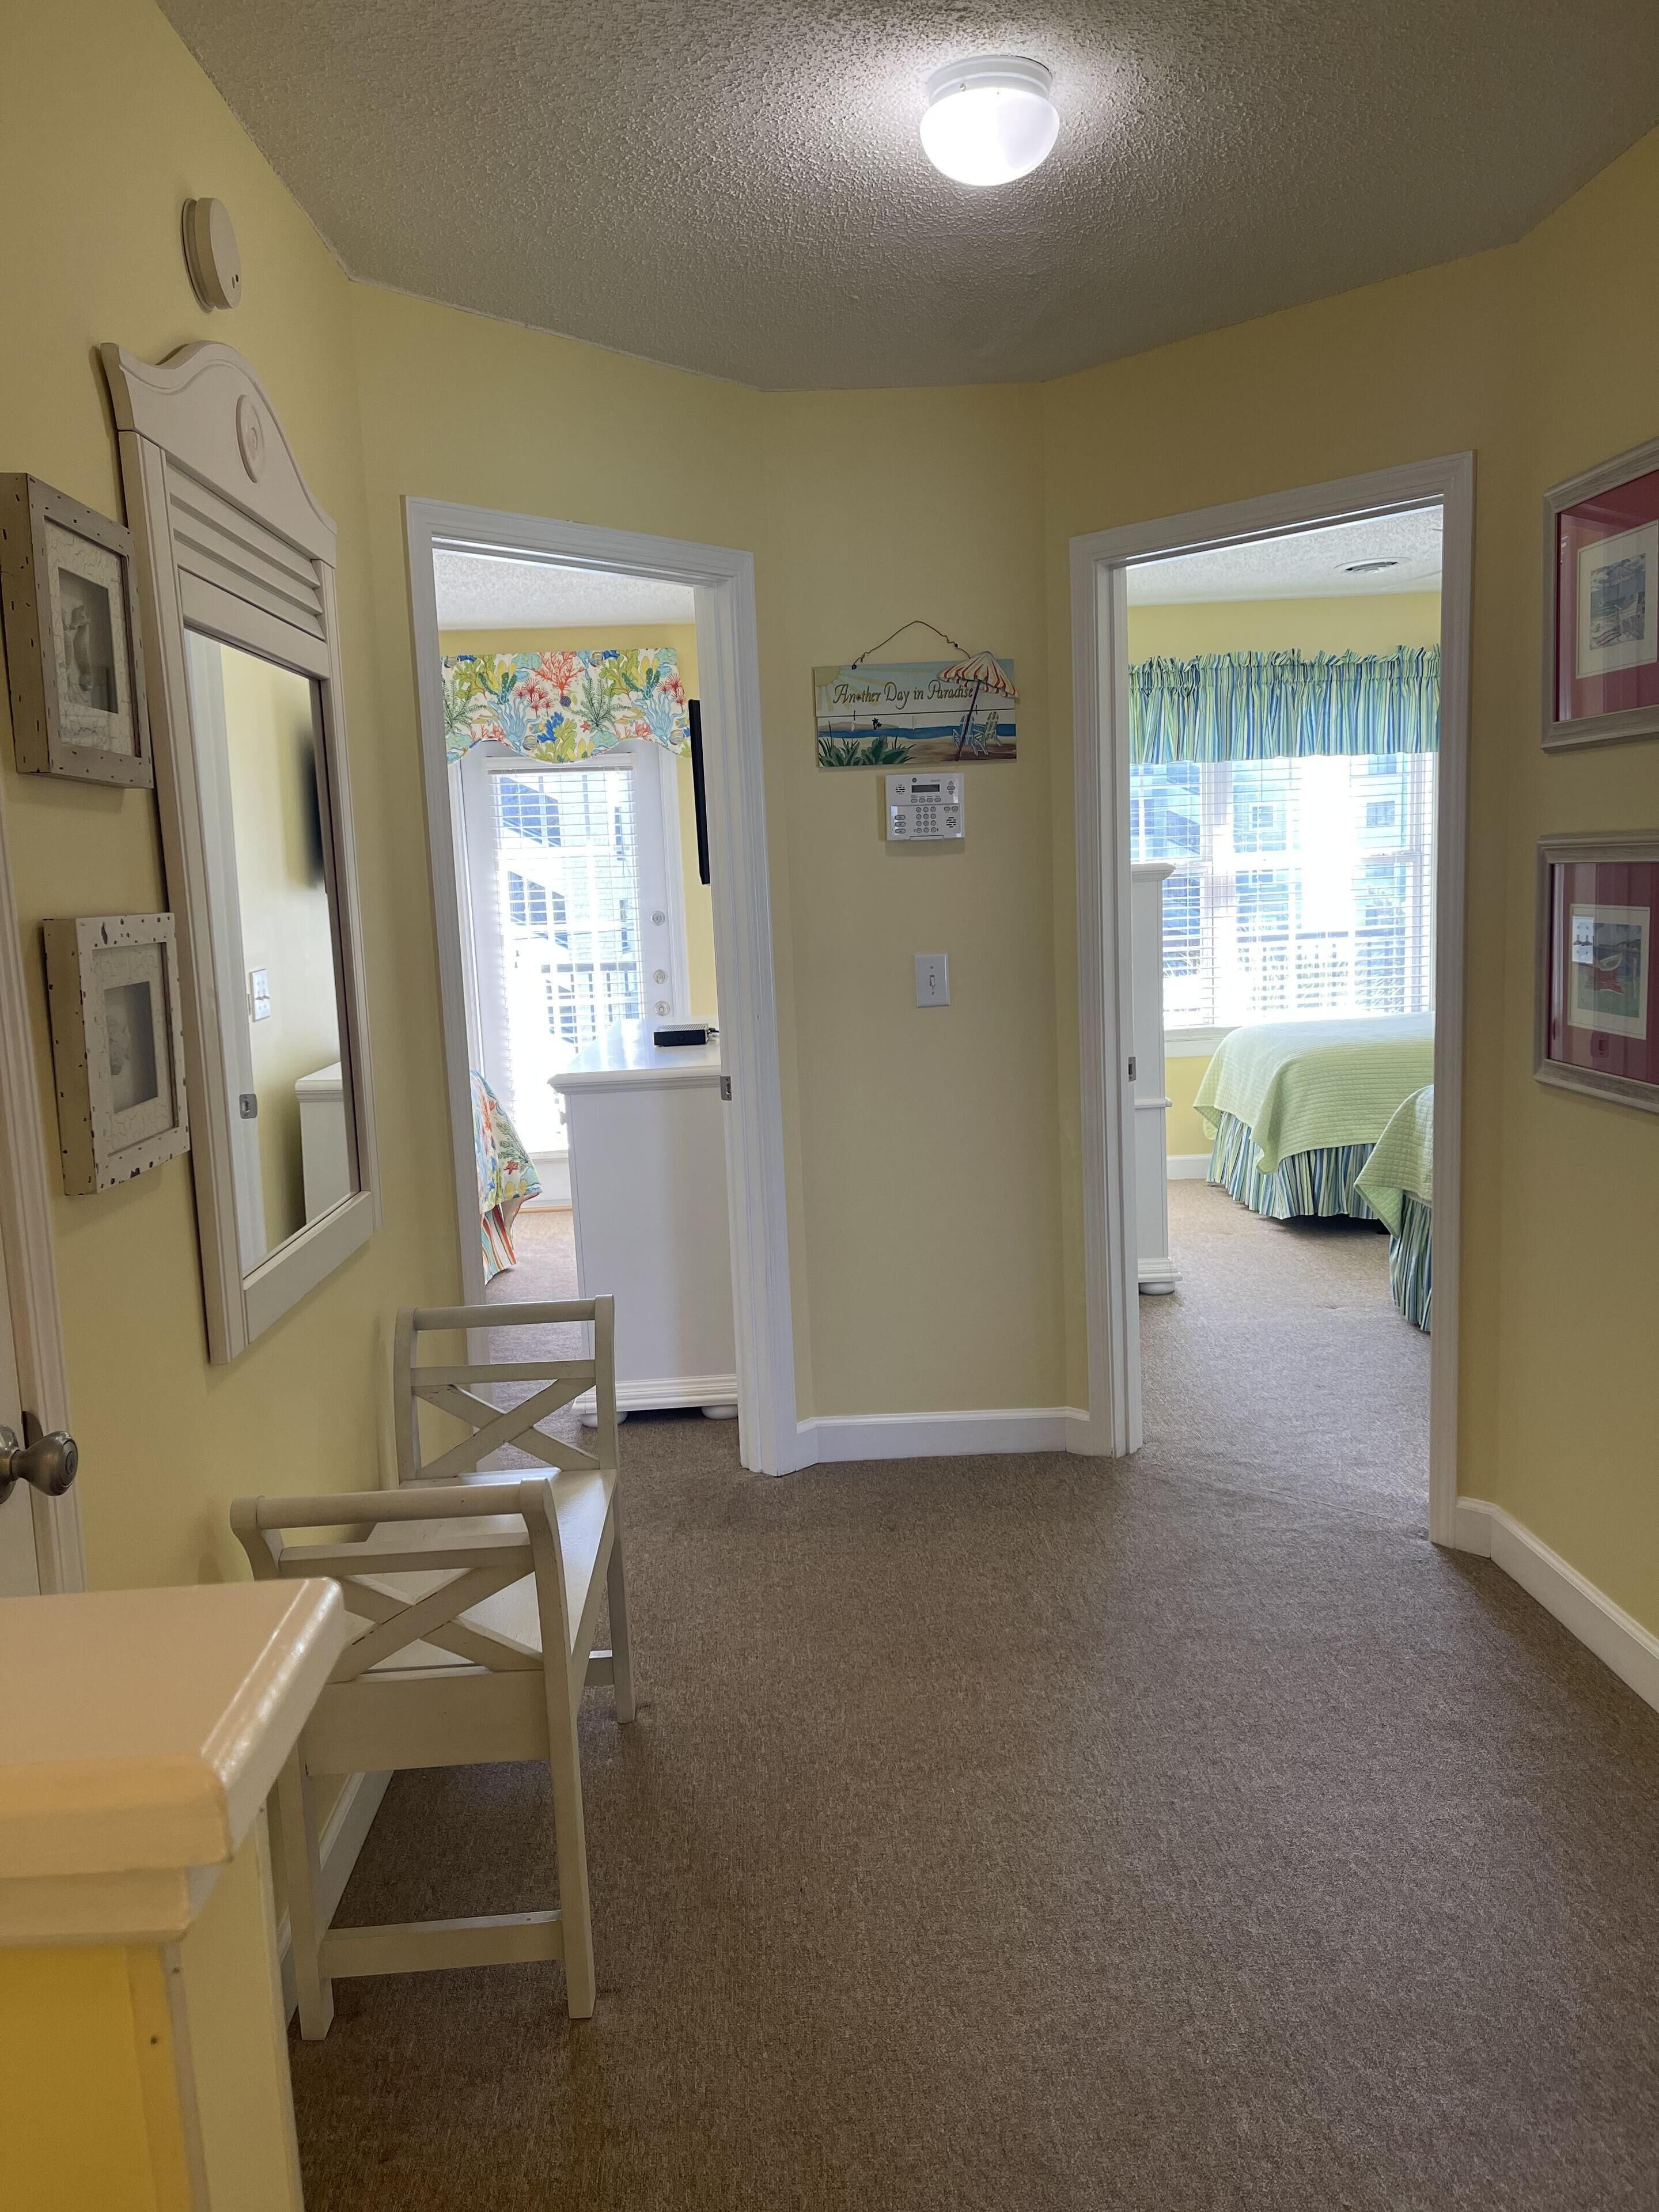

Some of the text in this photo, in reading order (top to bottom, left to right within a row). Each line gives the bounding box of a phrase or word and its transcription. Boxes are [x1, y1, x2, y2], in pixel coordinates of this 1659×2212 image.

[884, 681, 910, 710] Day
[914, 687, 924, 700] in
[927, 680, 974, 699] Paradise
